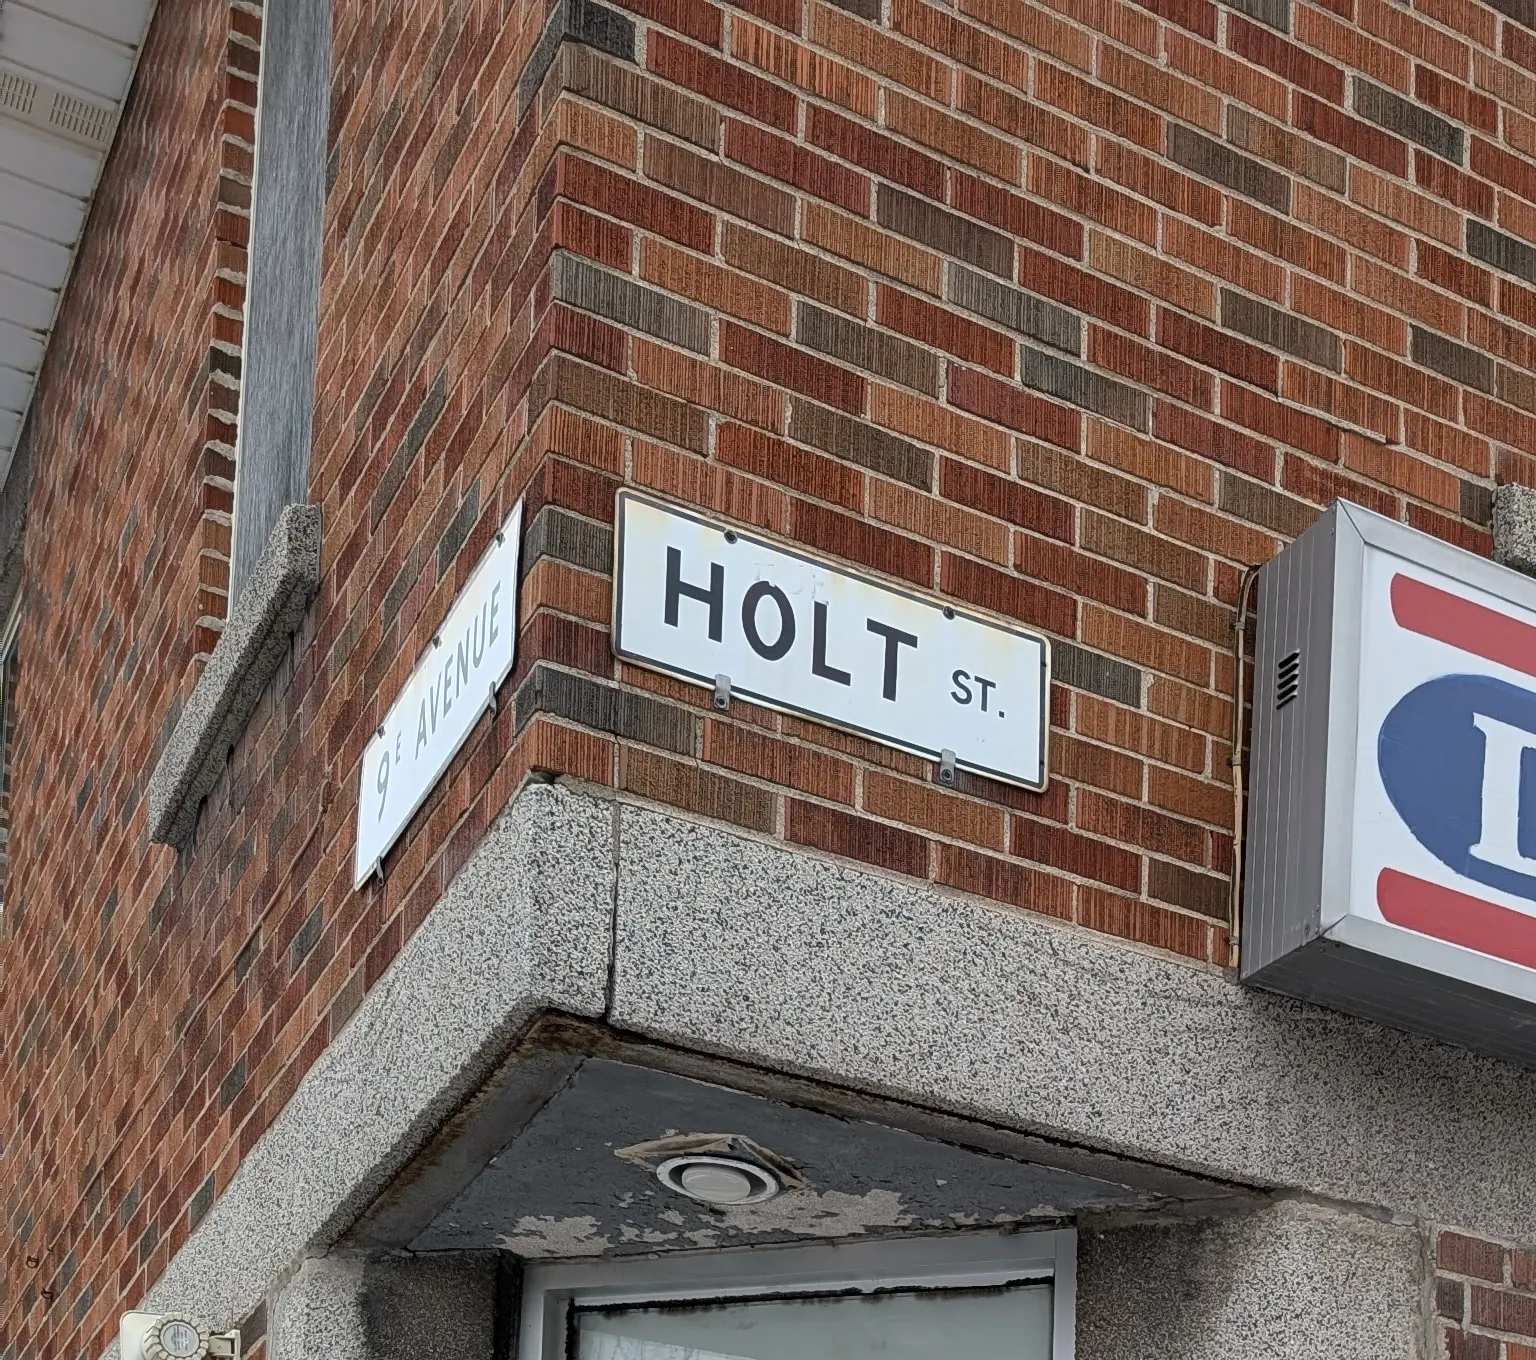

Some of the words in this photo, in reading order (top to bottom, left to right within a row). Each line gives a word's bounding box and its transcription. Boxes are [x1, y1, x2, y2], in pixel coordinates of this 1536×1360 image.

[414, 578, 501, 762] AVENUE
[664, 546, 918, 701] HOLT
[950, 669, 1005, 719] ST.
